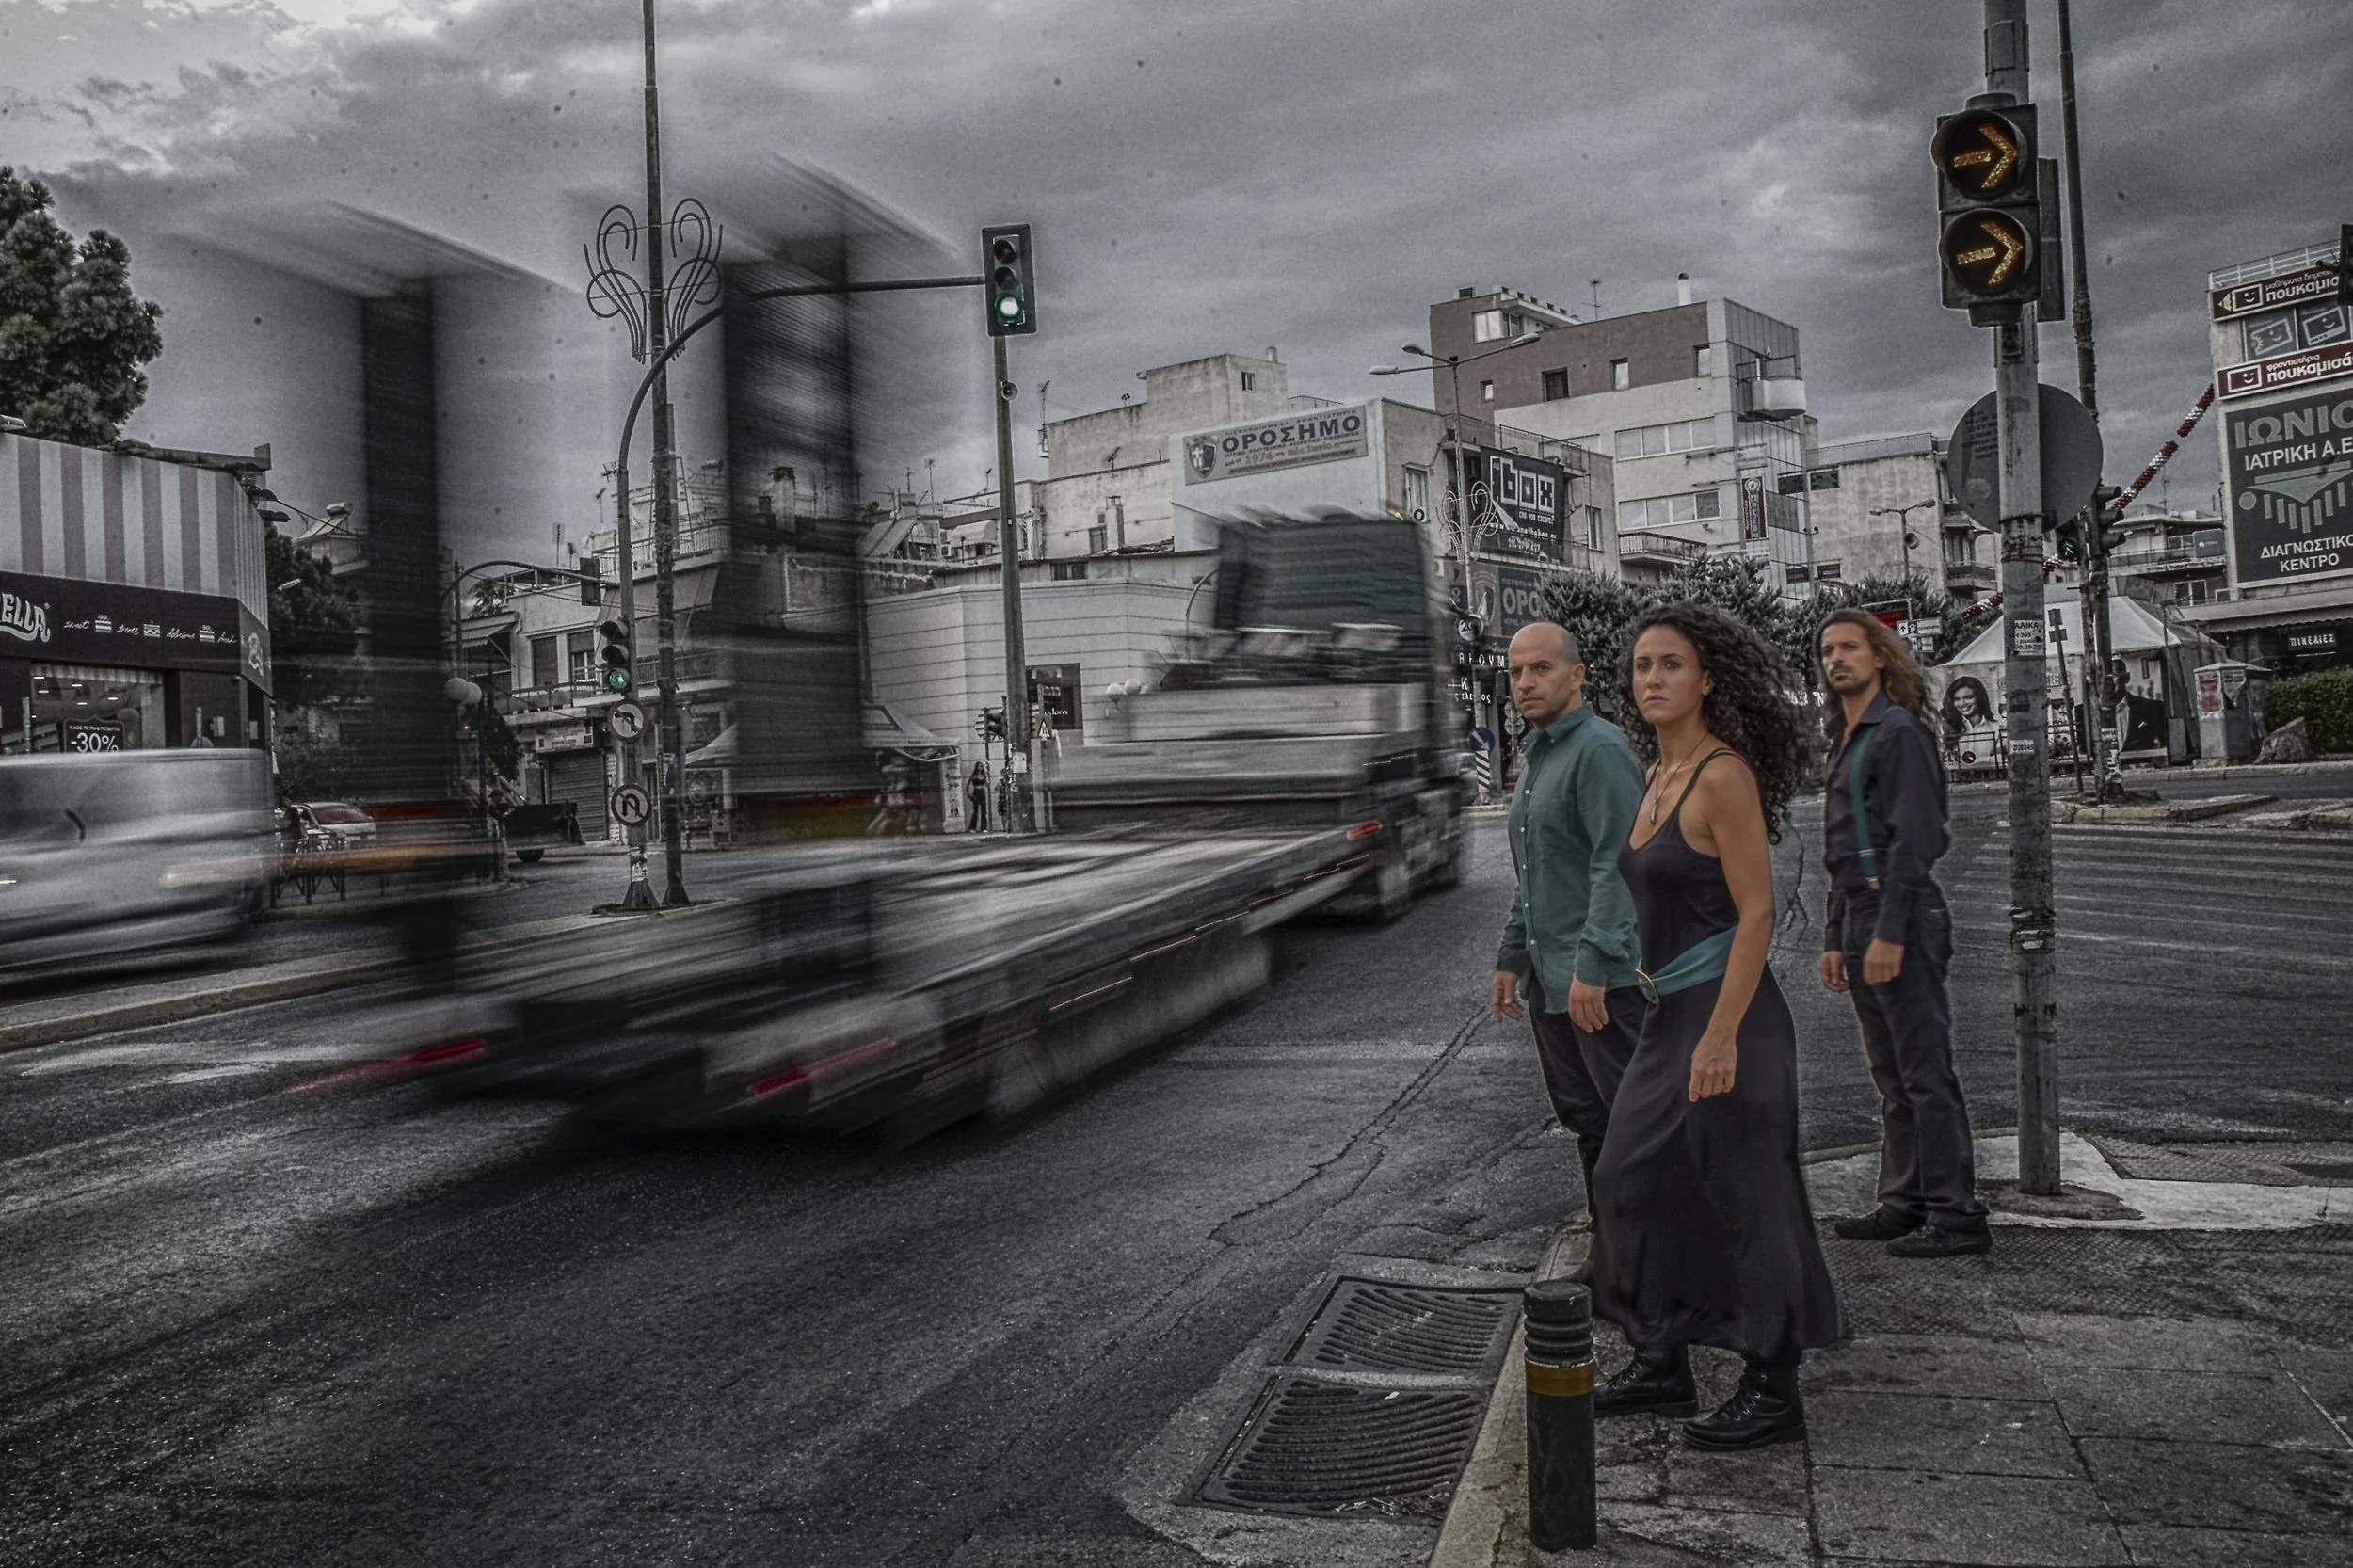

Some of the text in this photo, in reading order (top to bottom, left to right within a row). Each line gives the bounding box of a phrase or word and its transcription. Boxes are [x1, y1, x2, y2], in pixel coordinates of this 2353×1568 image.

[2266, 276, 2340, 302] πουκαμισ
[2266, 354, 2321, 372] φροντιστήρια
[2267, 351, 2353, 383] πουκαμισά
[1223, 415, 1361, 453] ΟΡΟΣΗΜΟ
[2244, 443, 2317, 471] ΙΑΤΡΙΚΗ
[2280, 552, 2340, 572] ΚΕΝΤΡΟ
[71, 732, 120, 753] -30%
